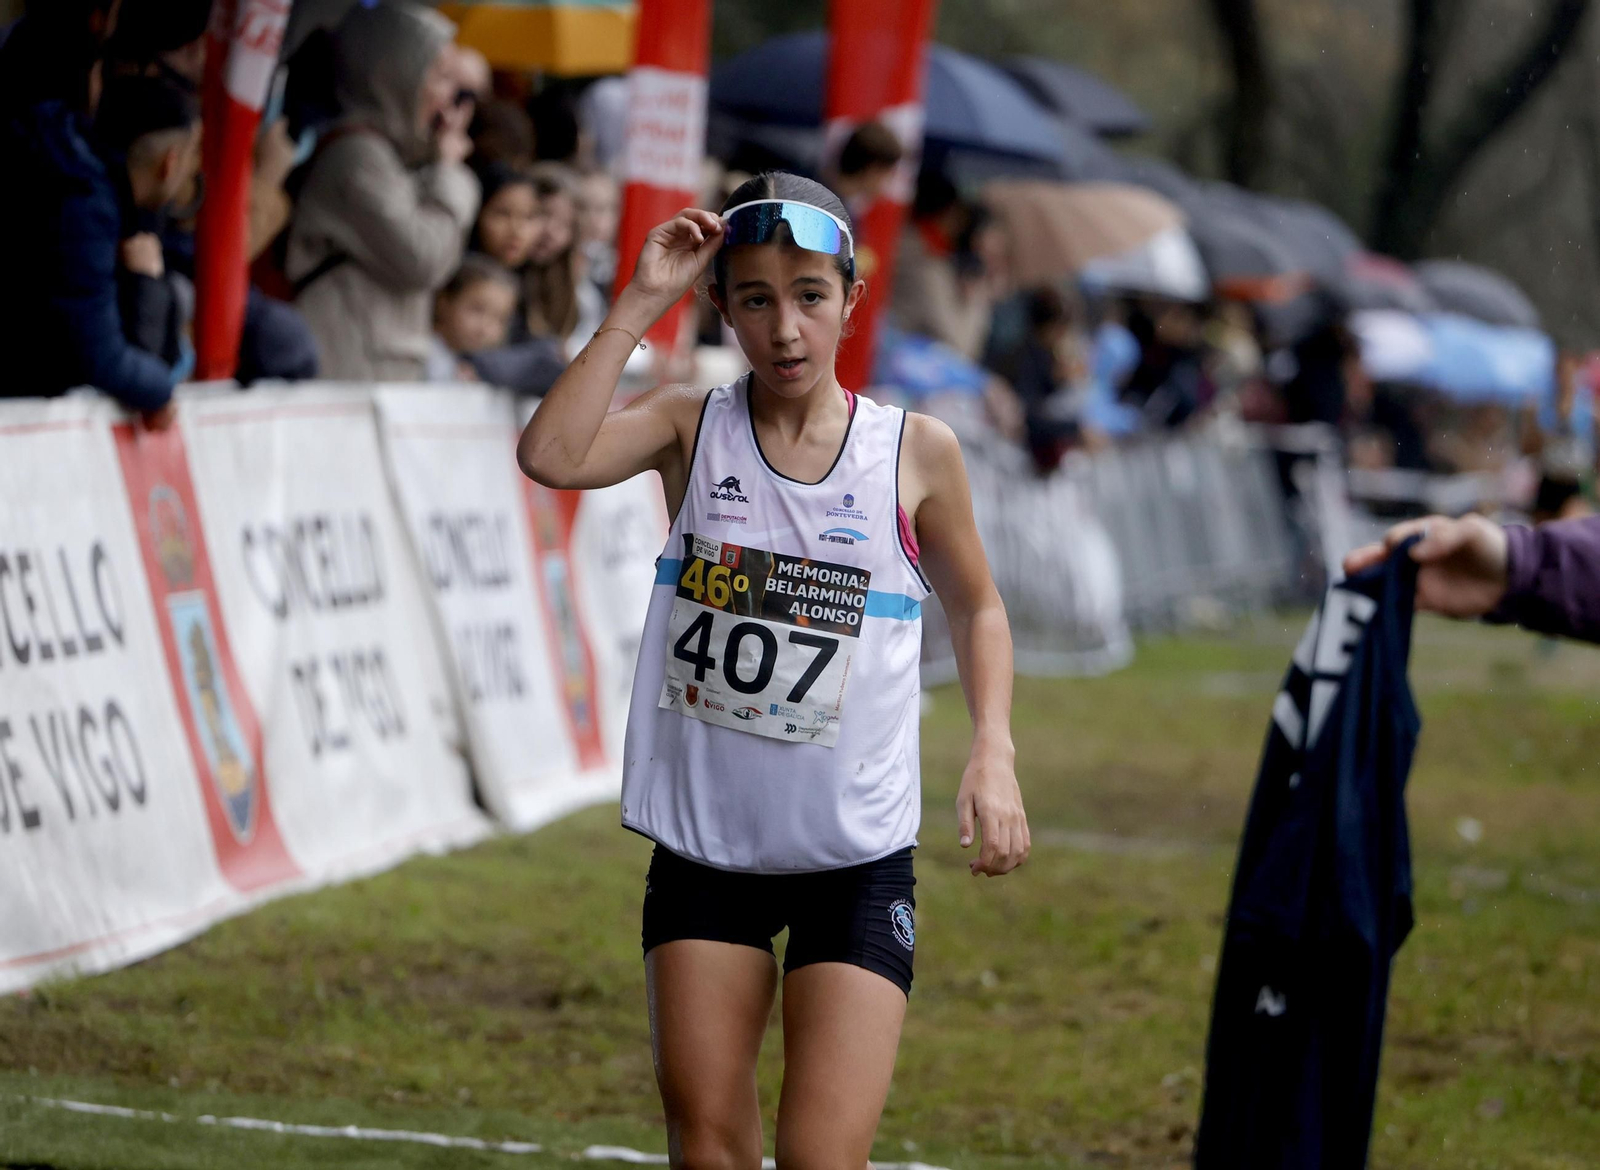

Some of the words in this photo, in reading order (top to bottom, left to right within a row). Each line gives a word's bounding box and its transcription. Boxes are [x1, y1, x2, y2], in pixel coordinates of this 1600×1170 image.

[826, 511, 868, 521] PONTEVEDRA
[695, 538, 719, 552] CONCELLO
[696, 546, 703, 554] DE
[704, 549, 715, 557] VIGO
[777, 561, 868, 590] MEMORIAL
[0, 543, 123, 664] CELLO
[765, 577, 866, 608] BELARMINO
[788, 602, 859, 626] ALONSO
[674, 611, 839, 703] 407
[710, 704, 725, 712] VIGO
[29, 698, 146, 822] VIGO
